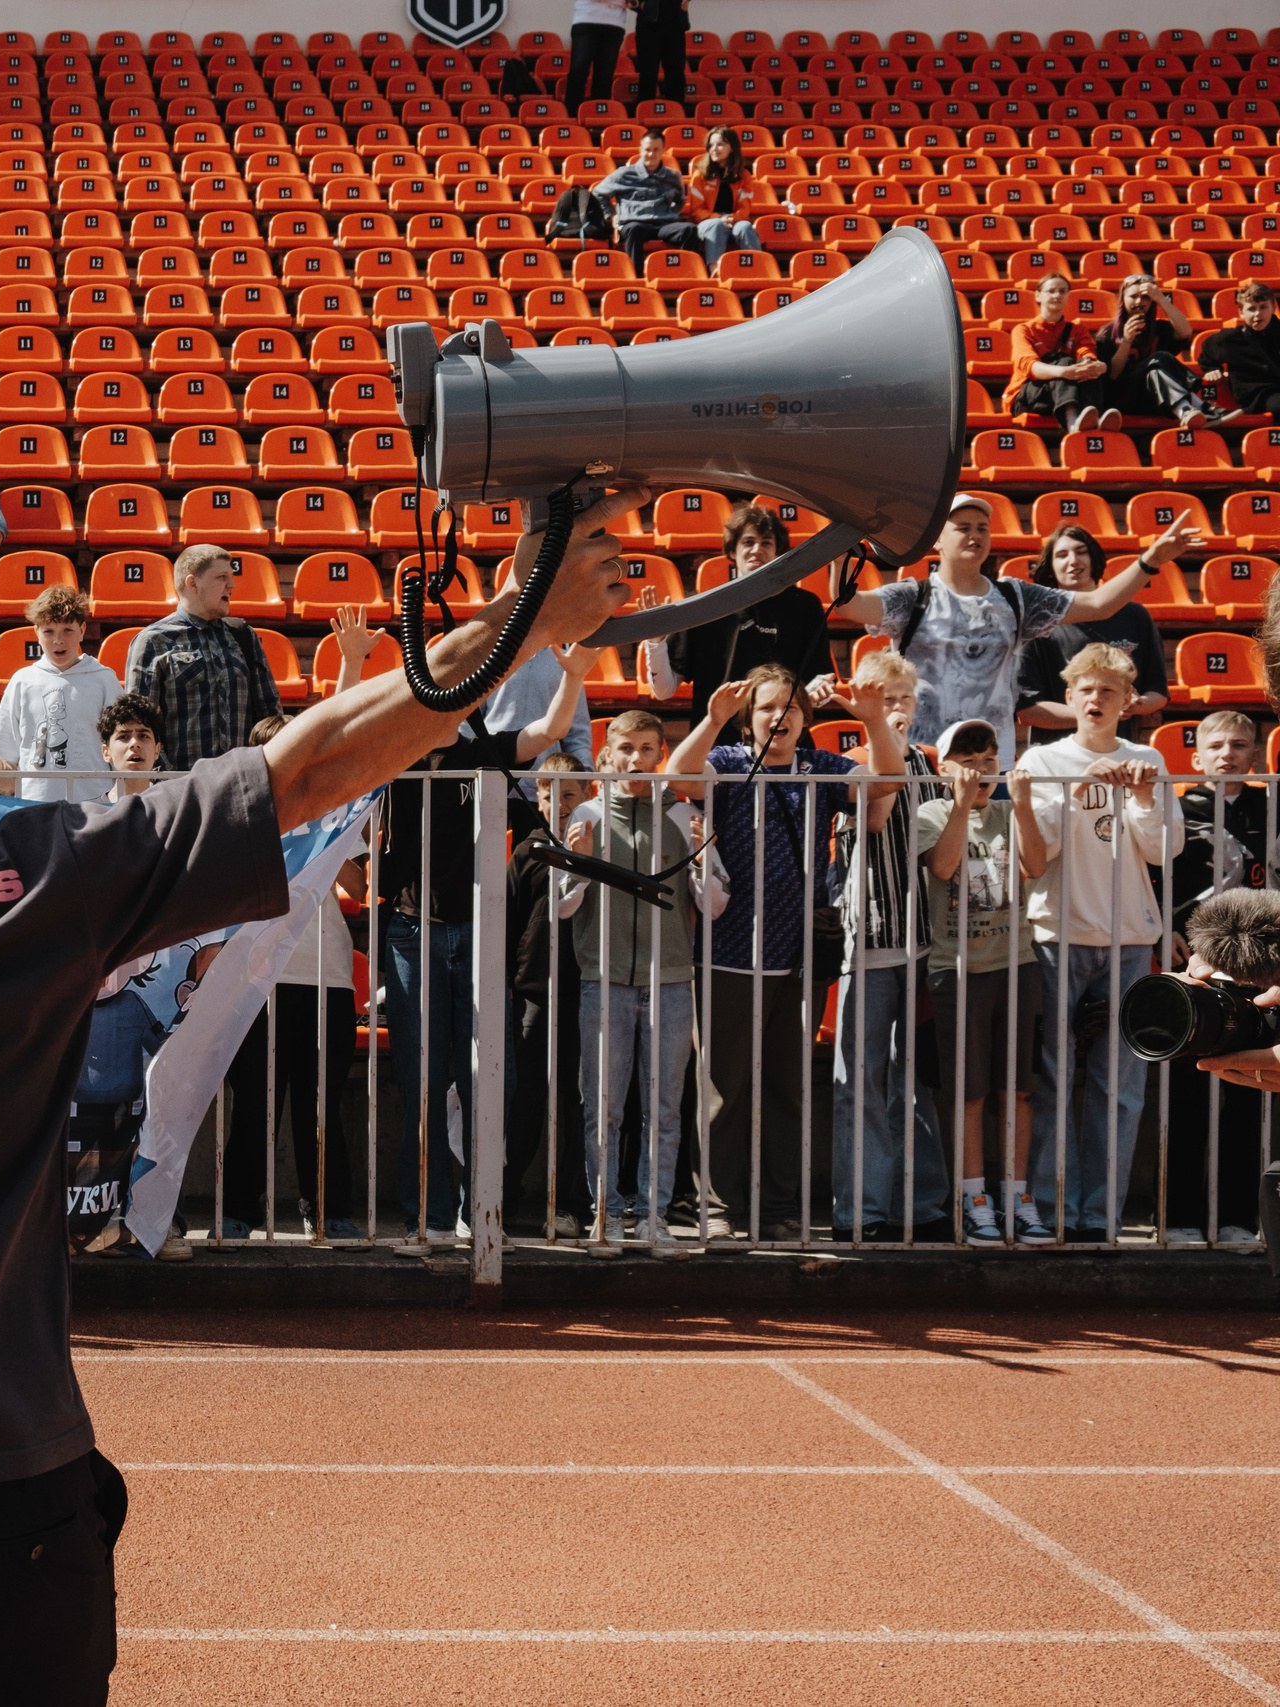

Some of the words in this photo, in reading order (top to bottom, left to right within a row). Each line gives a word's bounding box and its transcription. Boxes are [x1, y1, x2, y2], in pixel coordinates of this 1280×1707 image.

[810, 186, 820, 195] 23
[156, 218, 166, 226] 13
[432, 218, 441, 227] 17
[984, 218, 995, 227] 25
[1265, 220, 1276, 228] 29
[19, 258, 28, 267] 11
[92, 258, 102, 267] 12
[164, 259, 174, 268] 13
[308, 261, 318, 270] 15
[668, 256, 679, 265] 20
[960, 257, 971, 266] 24
[1178, 265, 1189, 274] 27
[94, 292, 104, 301] 12
[248, 290, 258, 299] 14
[399, 290, 410, 298] 16
[475, 294, 486, 303] 17
[552, 294, 563, 303] 18
[627, 293, 638, 302] 19
[1006, 293, 1018, 302] 24
[172, 296, 182, 306] 13
[327, 299, 337, 308] 15
[702, 295, 713, 305] 20
[19, 302, 28, 311] 11
[1081, 302, 1092, 311] 25
[21, 339, 30, 348] 11
[102, 339, 113, 348] 12
[180, 339, 191, 349] 13
[261, 341, 272, 351] 14
[342, 339, 353, 349] 15
[978, 340, 991, 349] 23
[23, 384, 33, 394] 11
[106, 385, 118, 395] 12
[190, 382, 202, 392] 13
[276, 387, 287, 396] 14
[361, 386, 372, 397] 15
[1203, 388, 1216, 397] 25
[113, 432, 125, 442] 12
[202, 432, 214, 443] 13
[379, 436, 391, 447] 15
[1000, 436, 1013, 447] 22
[1179, 432, 1193, 443] 24
[23, 440, 34, 451] 11
[293, 440, 305, 450] 14
[1089, 440, 1102, 450] 23
[26, 494, 37, 504] 11
[216, 494, 228, 505] 13
[309, 497, 322, 508] 14
[404, 496, 416, 507] 15
[686, 498, 700, 508] 18
[122, 502, 134, 513] 12
[1062, 502, 1076, 514] 22
[1254, 499, 1269, 510] 24
[495, 510, 508, 522] 16
[782, 507, 795, 518] 19
[1158, 510, 1172, 522] 23
[128, 567, 141, 579] 12
[332, 566, 346, 578] 14
[630, 564, 642, 575] 17
[1234, 565, 1249, 576] 23
[29, 570, 41, 581] 11
[1209, 657, 1225, 669] 22
[842, 736, 857, 749] 18
